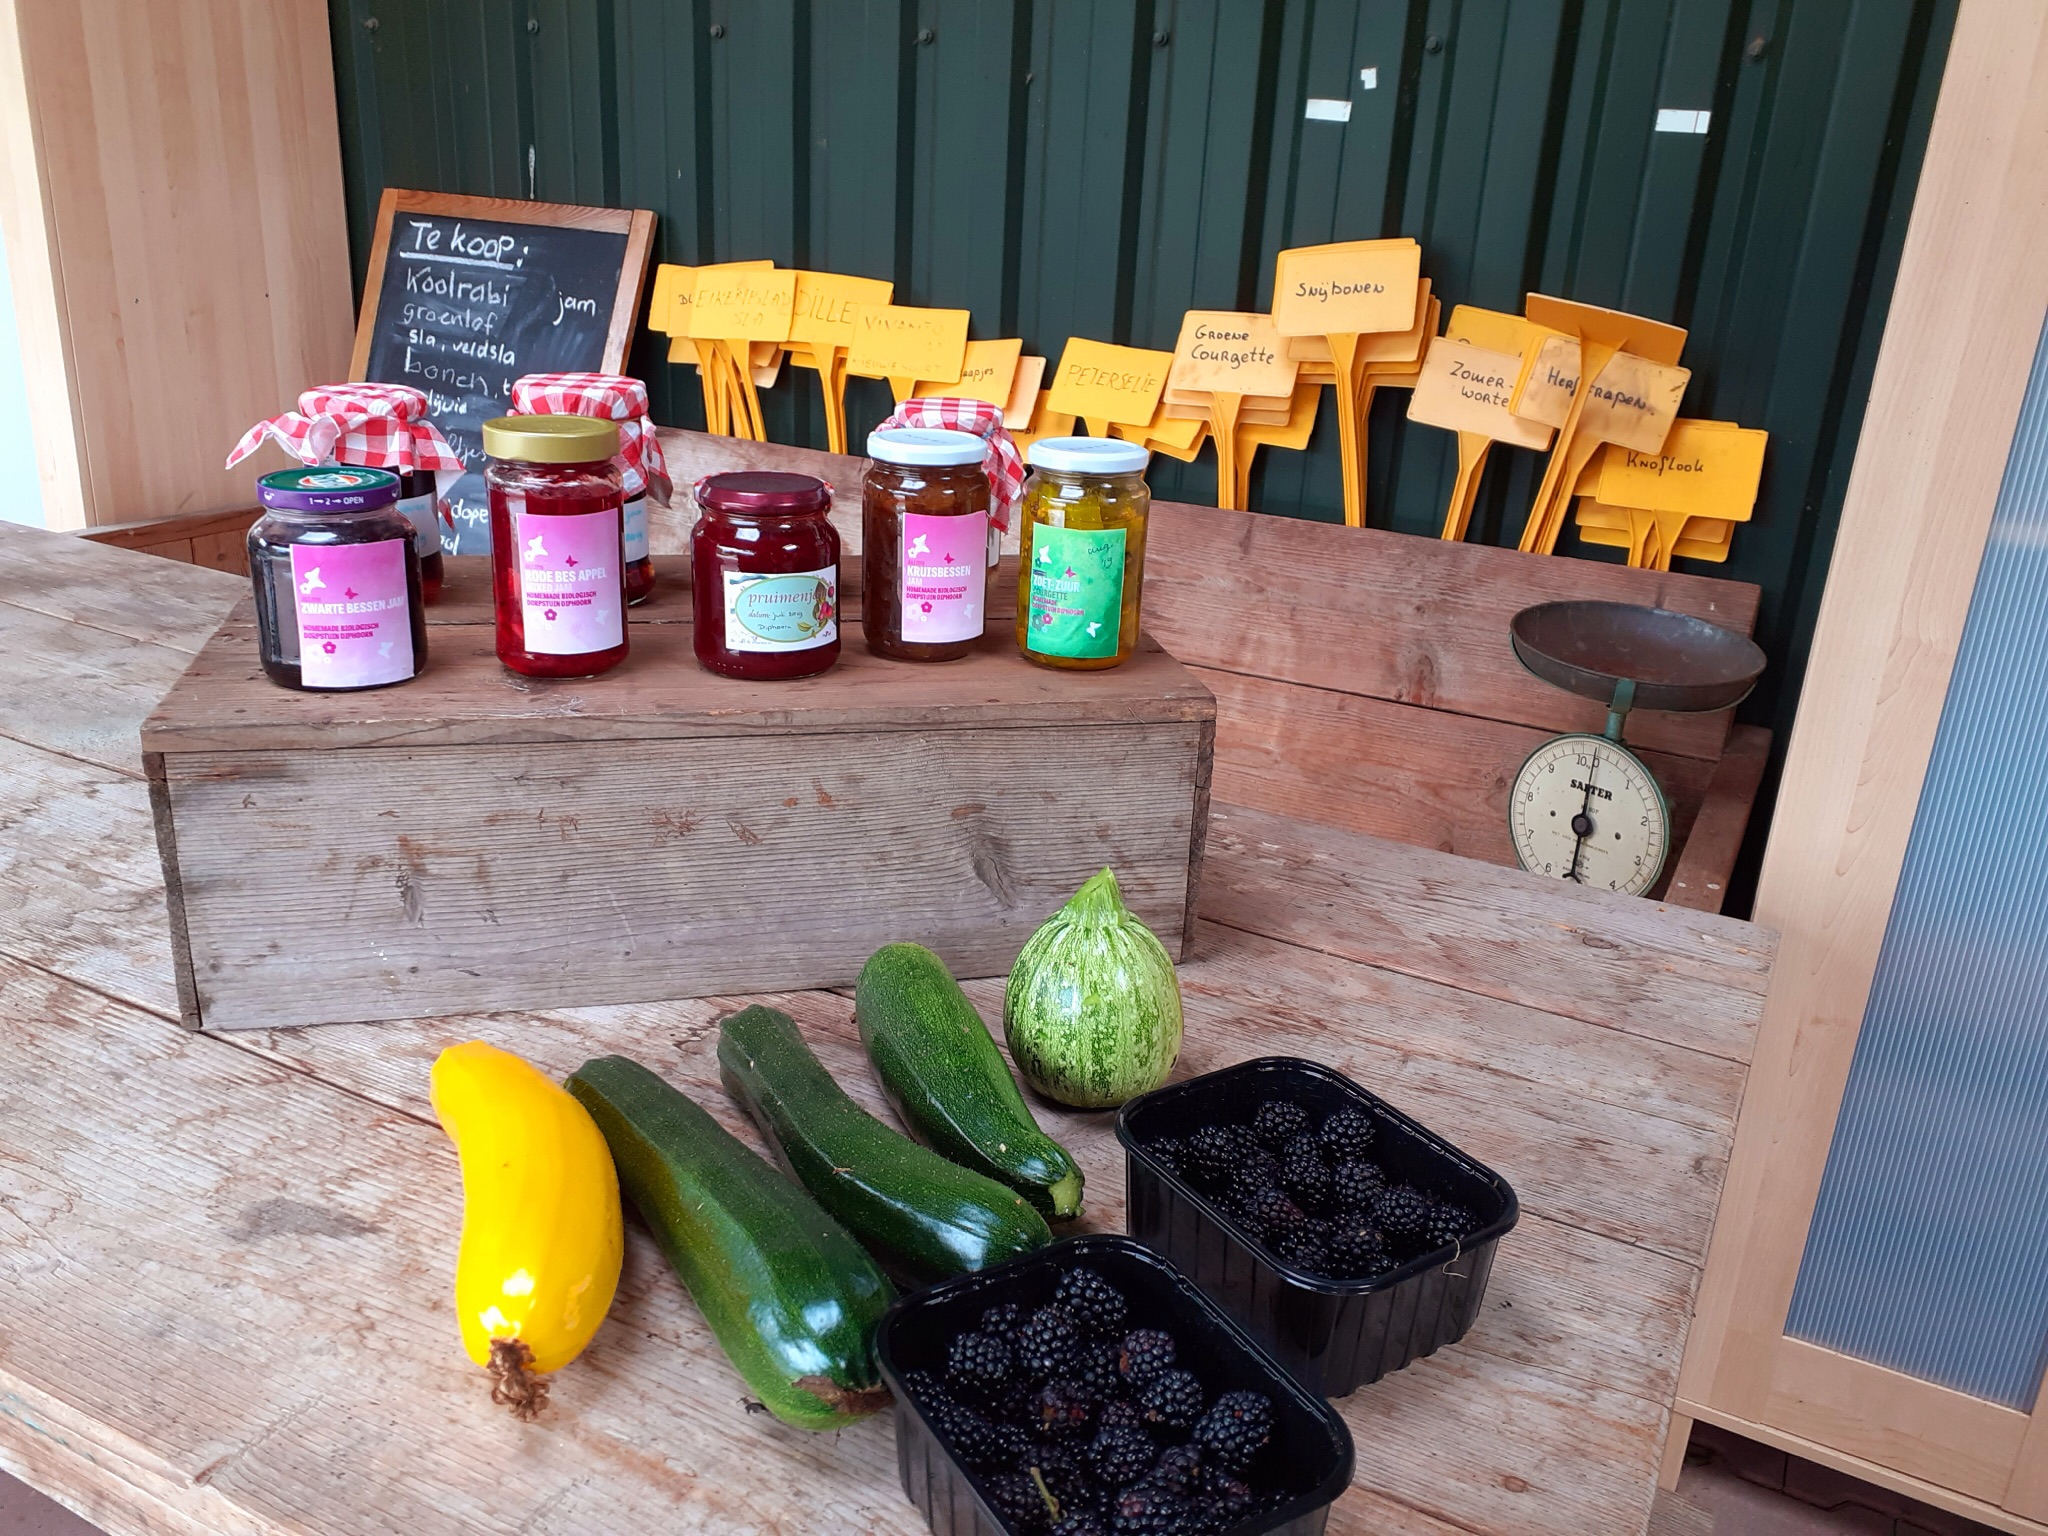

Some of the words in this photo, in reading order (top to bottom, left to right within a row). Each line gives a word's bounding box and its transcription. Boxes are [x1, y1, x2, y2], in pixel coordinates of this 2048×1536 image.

[409, 220, 442, 251] Te
[552, 291, 597, 326] jam
[453, 339, 516, 366] veldsla
[1191, 344, 1275, 369] Courgette
[961, 367, 994, 382] aapjes
[1461, 386, 1510, 407] worte
[1626, 451, 1704, 477] Knoflook
[343, 496, 364, 505] OPEN
[525, 569, 554, 583] RODE
[555, 570, 577, 583] BES
[578, 567, 607, 581] APPEL
[907, 564, 971, 578] KRUISBESSEN
[907, 577, 923, 586] JAM
[554, 583, 573, 592] JAM
[907, 585, 937, 594] HOMEMADE
[526, 592, 560, 600] HOMEMADE
[561, 591, 597, 600] BIOLOGISCH
[301, 602, 345, 615] ZWARTE
[346, 600, 386, 614] BESSEN
[527, 599, 560, 607] DORPSTUIN
[561, 599, 592, 607] DIPHOORN
[303, 624, 339, 632] HOMEMADE
[1576, 754, 1588, 767] 10
[1548, 763, 1555, 774] 9
[1625, 779, 1630, 790] 1
[1527, 791, 1534, 802] 8
[1640, 815, 1648, 827] 2
[1527, 829, 1535, 840] 7
[1634, 856, 1642, 867] 3
[1545, 862, 1552, 873] 6
[1609, 880, 1617, 890] 4
